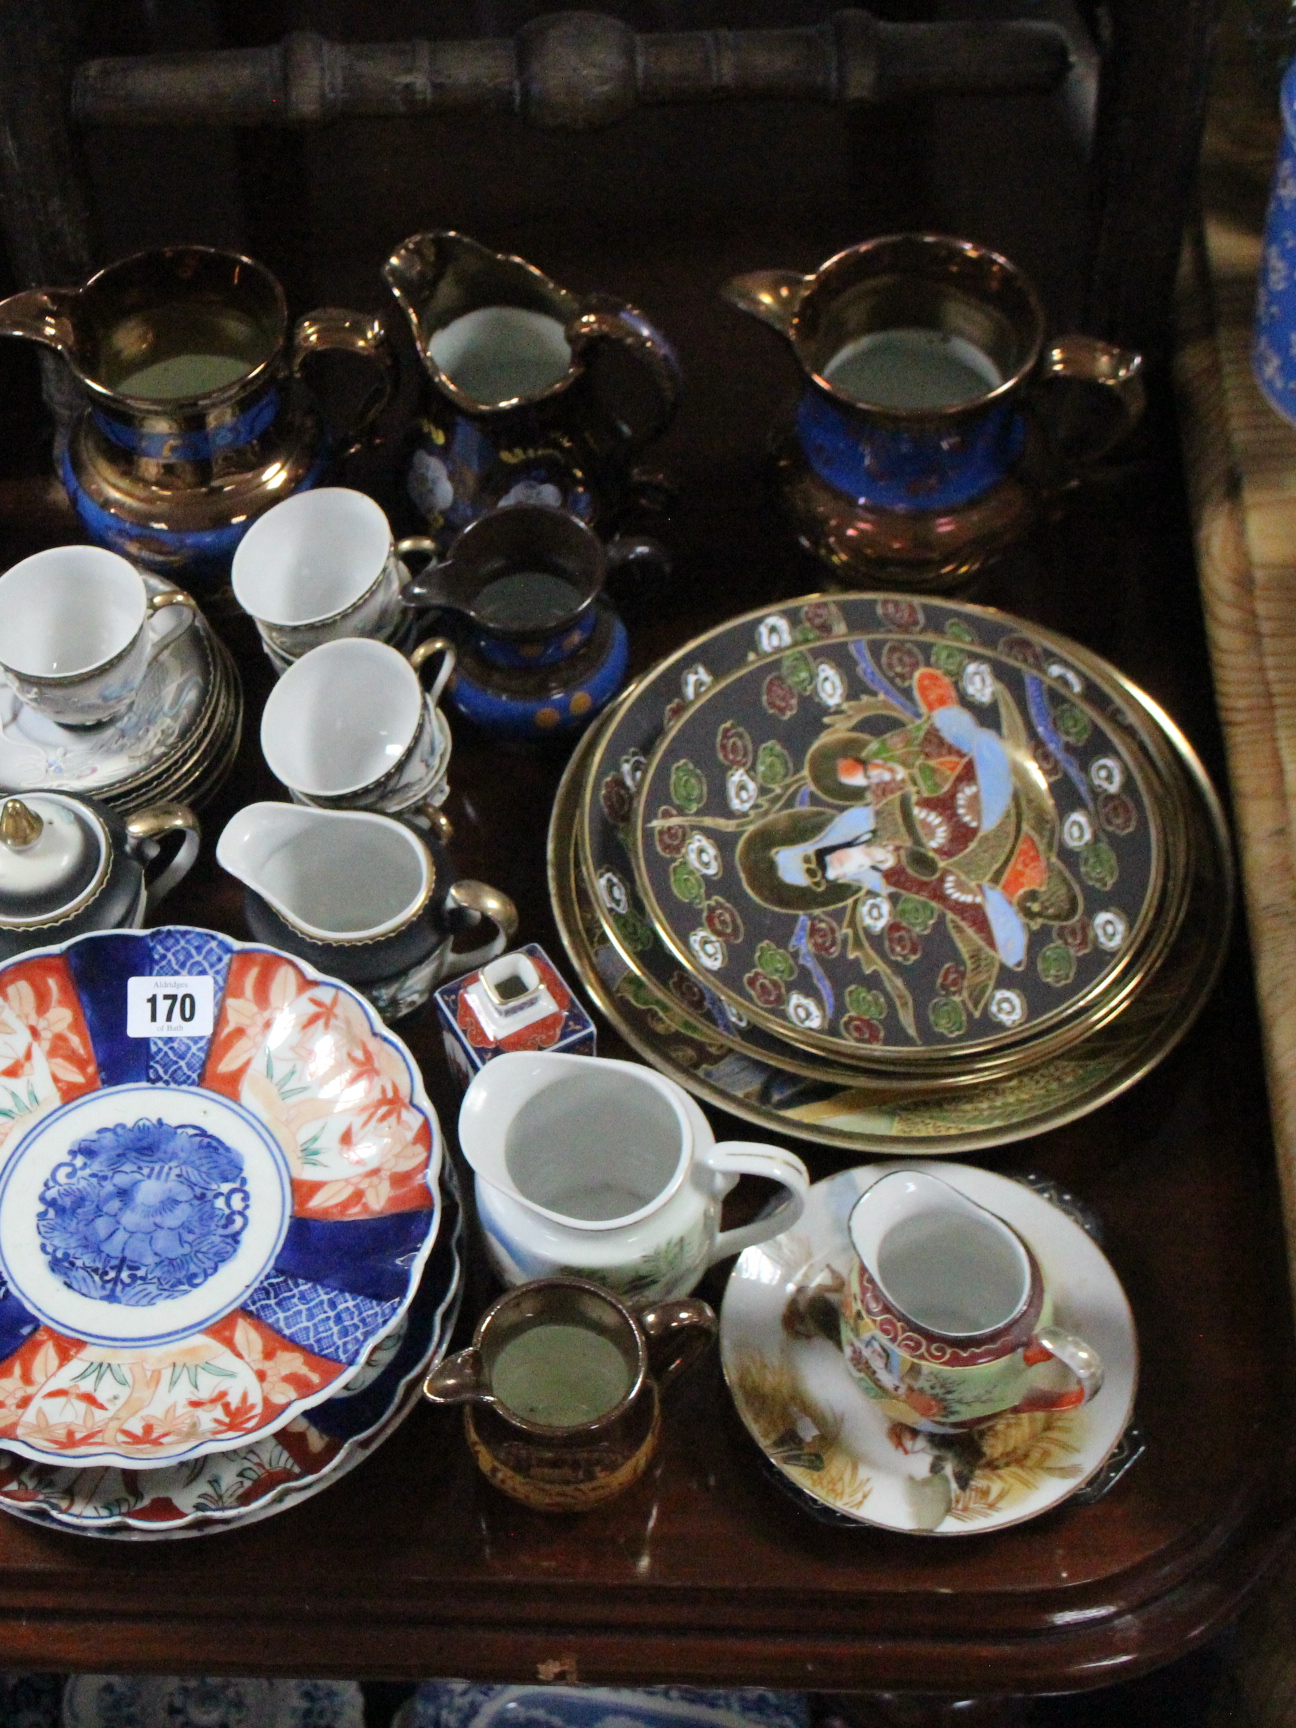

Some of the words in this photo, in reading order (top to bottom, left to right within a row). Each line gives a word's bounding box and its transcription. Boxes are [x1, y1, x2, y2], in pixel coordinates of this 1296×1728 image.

[153, 980, 189, 990] Aldridges
[146, 993, 196, 1023] 170
[156, 1024, 165, 1032] of
[166, 1024, 184, 1032] Bath
